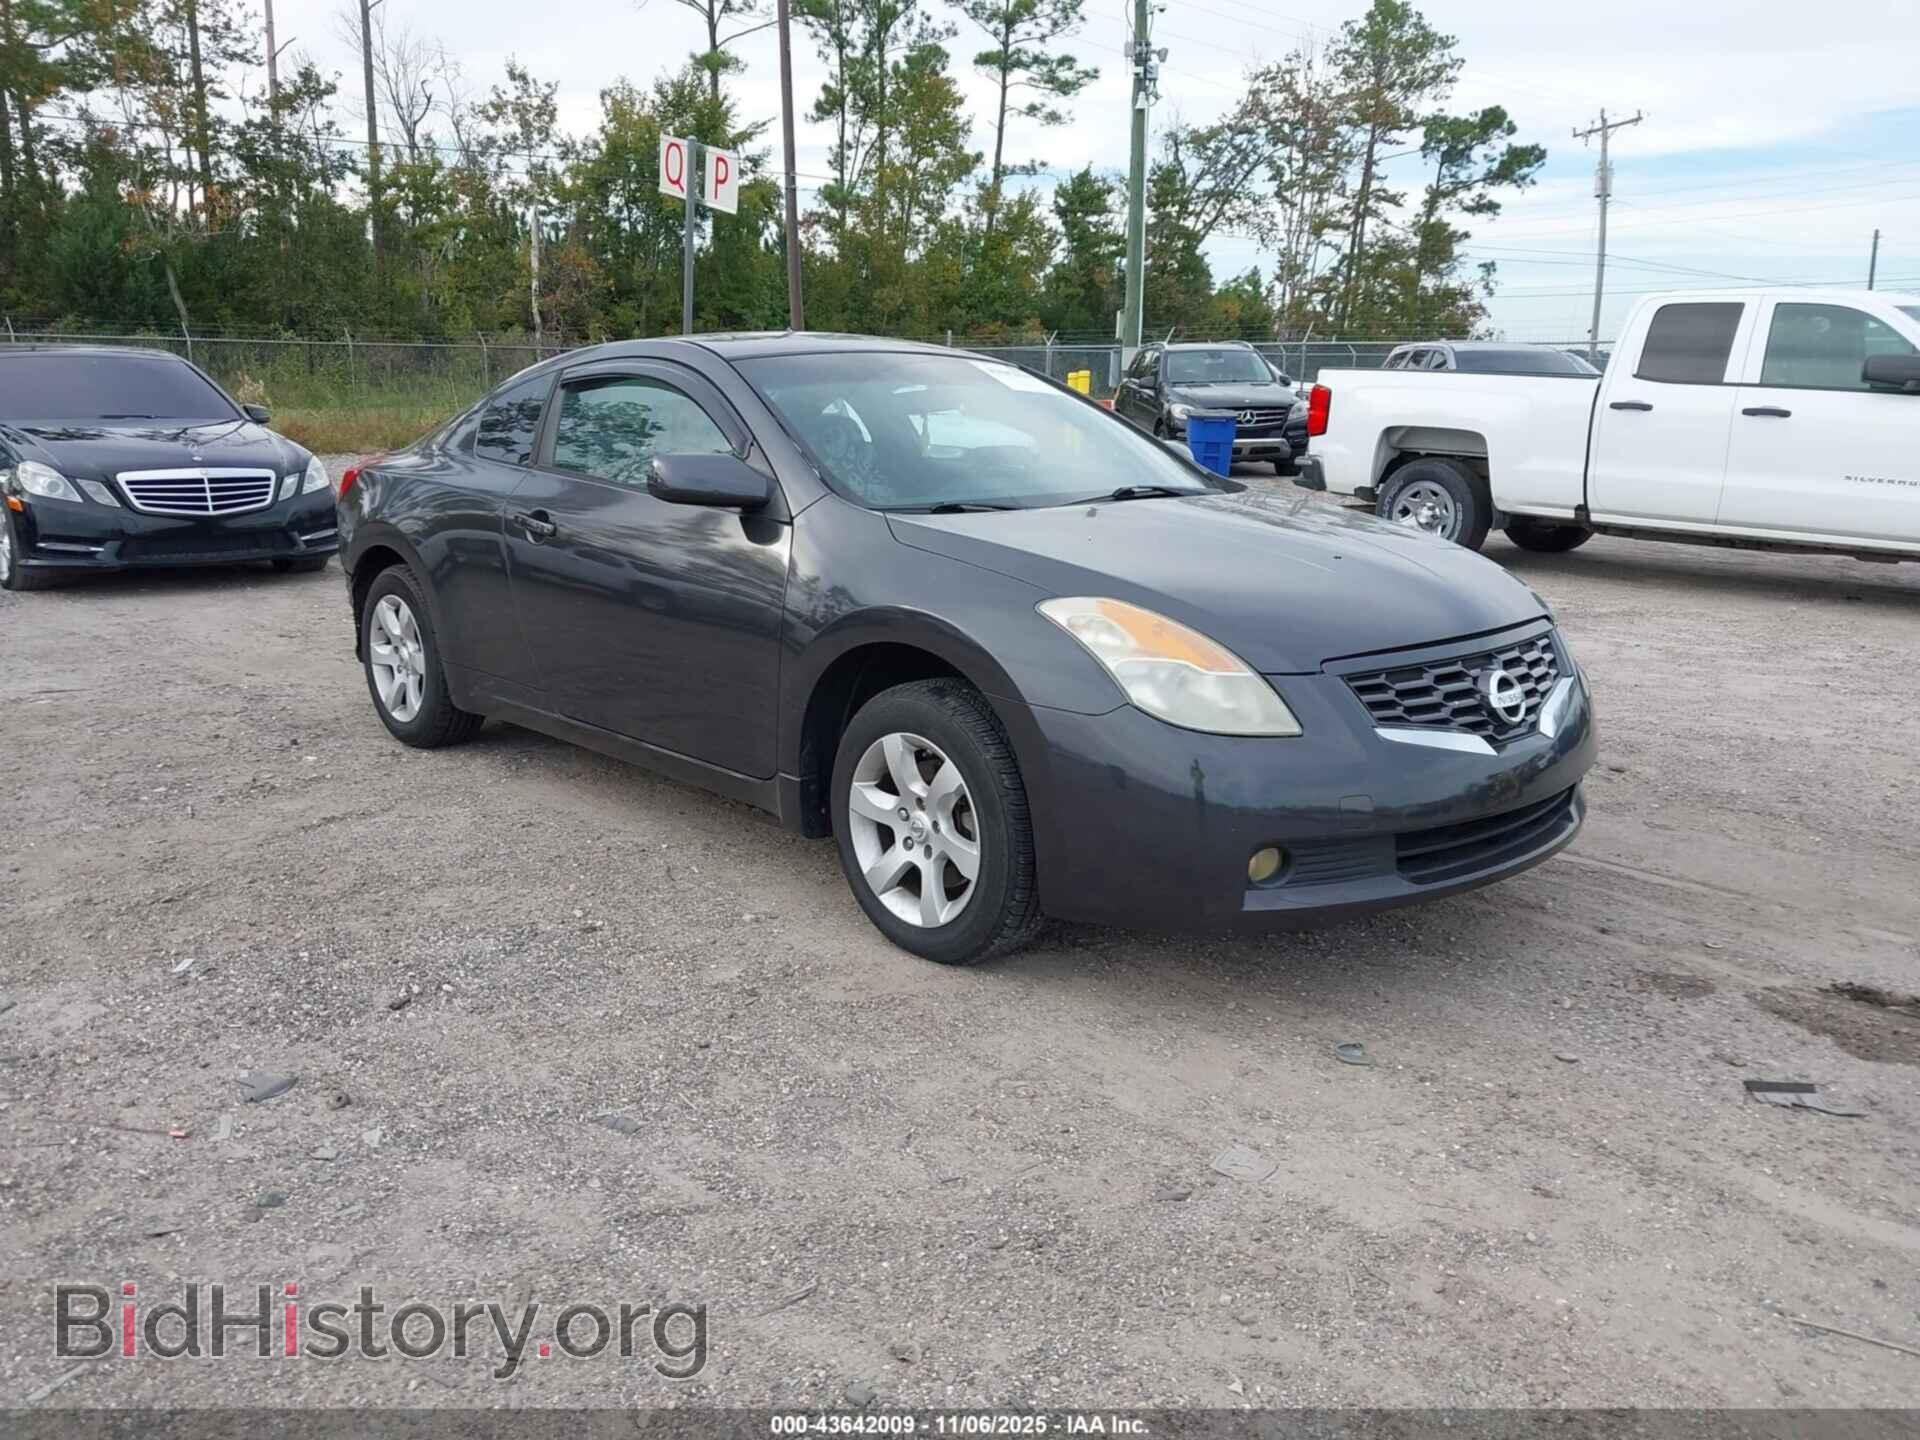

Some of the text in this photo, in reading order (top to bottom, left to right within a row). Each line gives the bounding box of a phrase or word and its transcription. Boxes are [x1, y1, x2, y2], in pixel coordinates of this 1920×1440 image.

[665, 143, 685, 192] Q
[714, 156, 728, 200] P
[1844, 475, 1920, 487] SILVERAD
